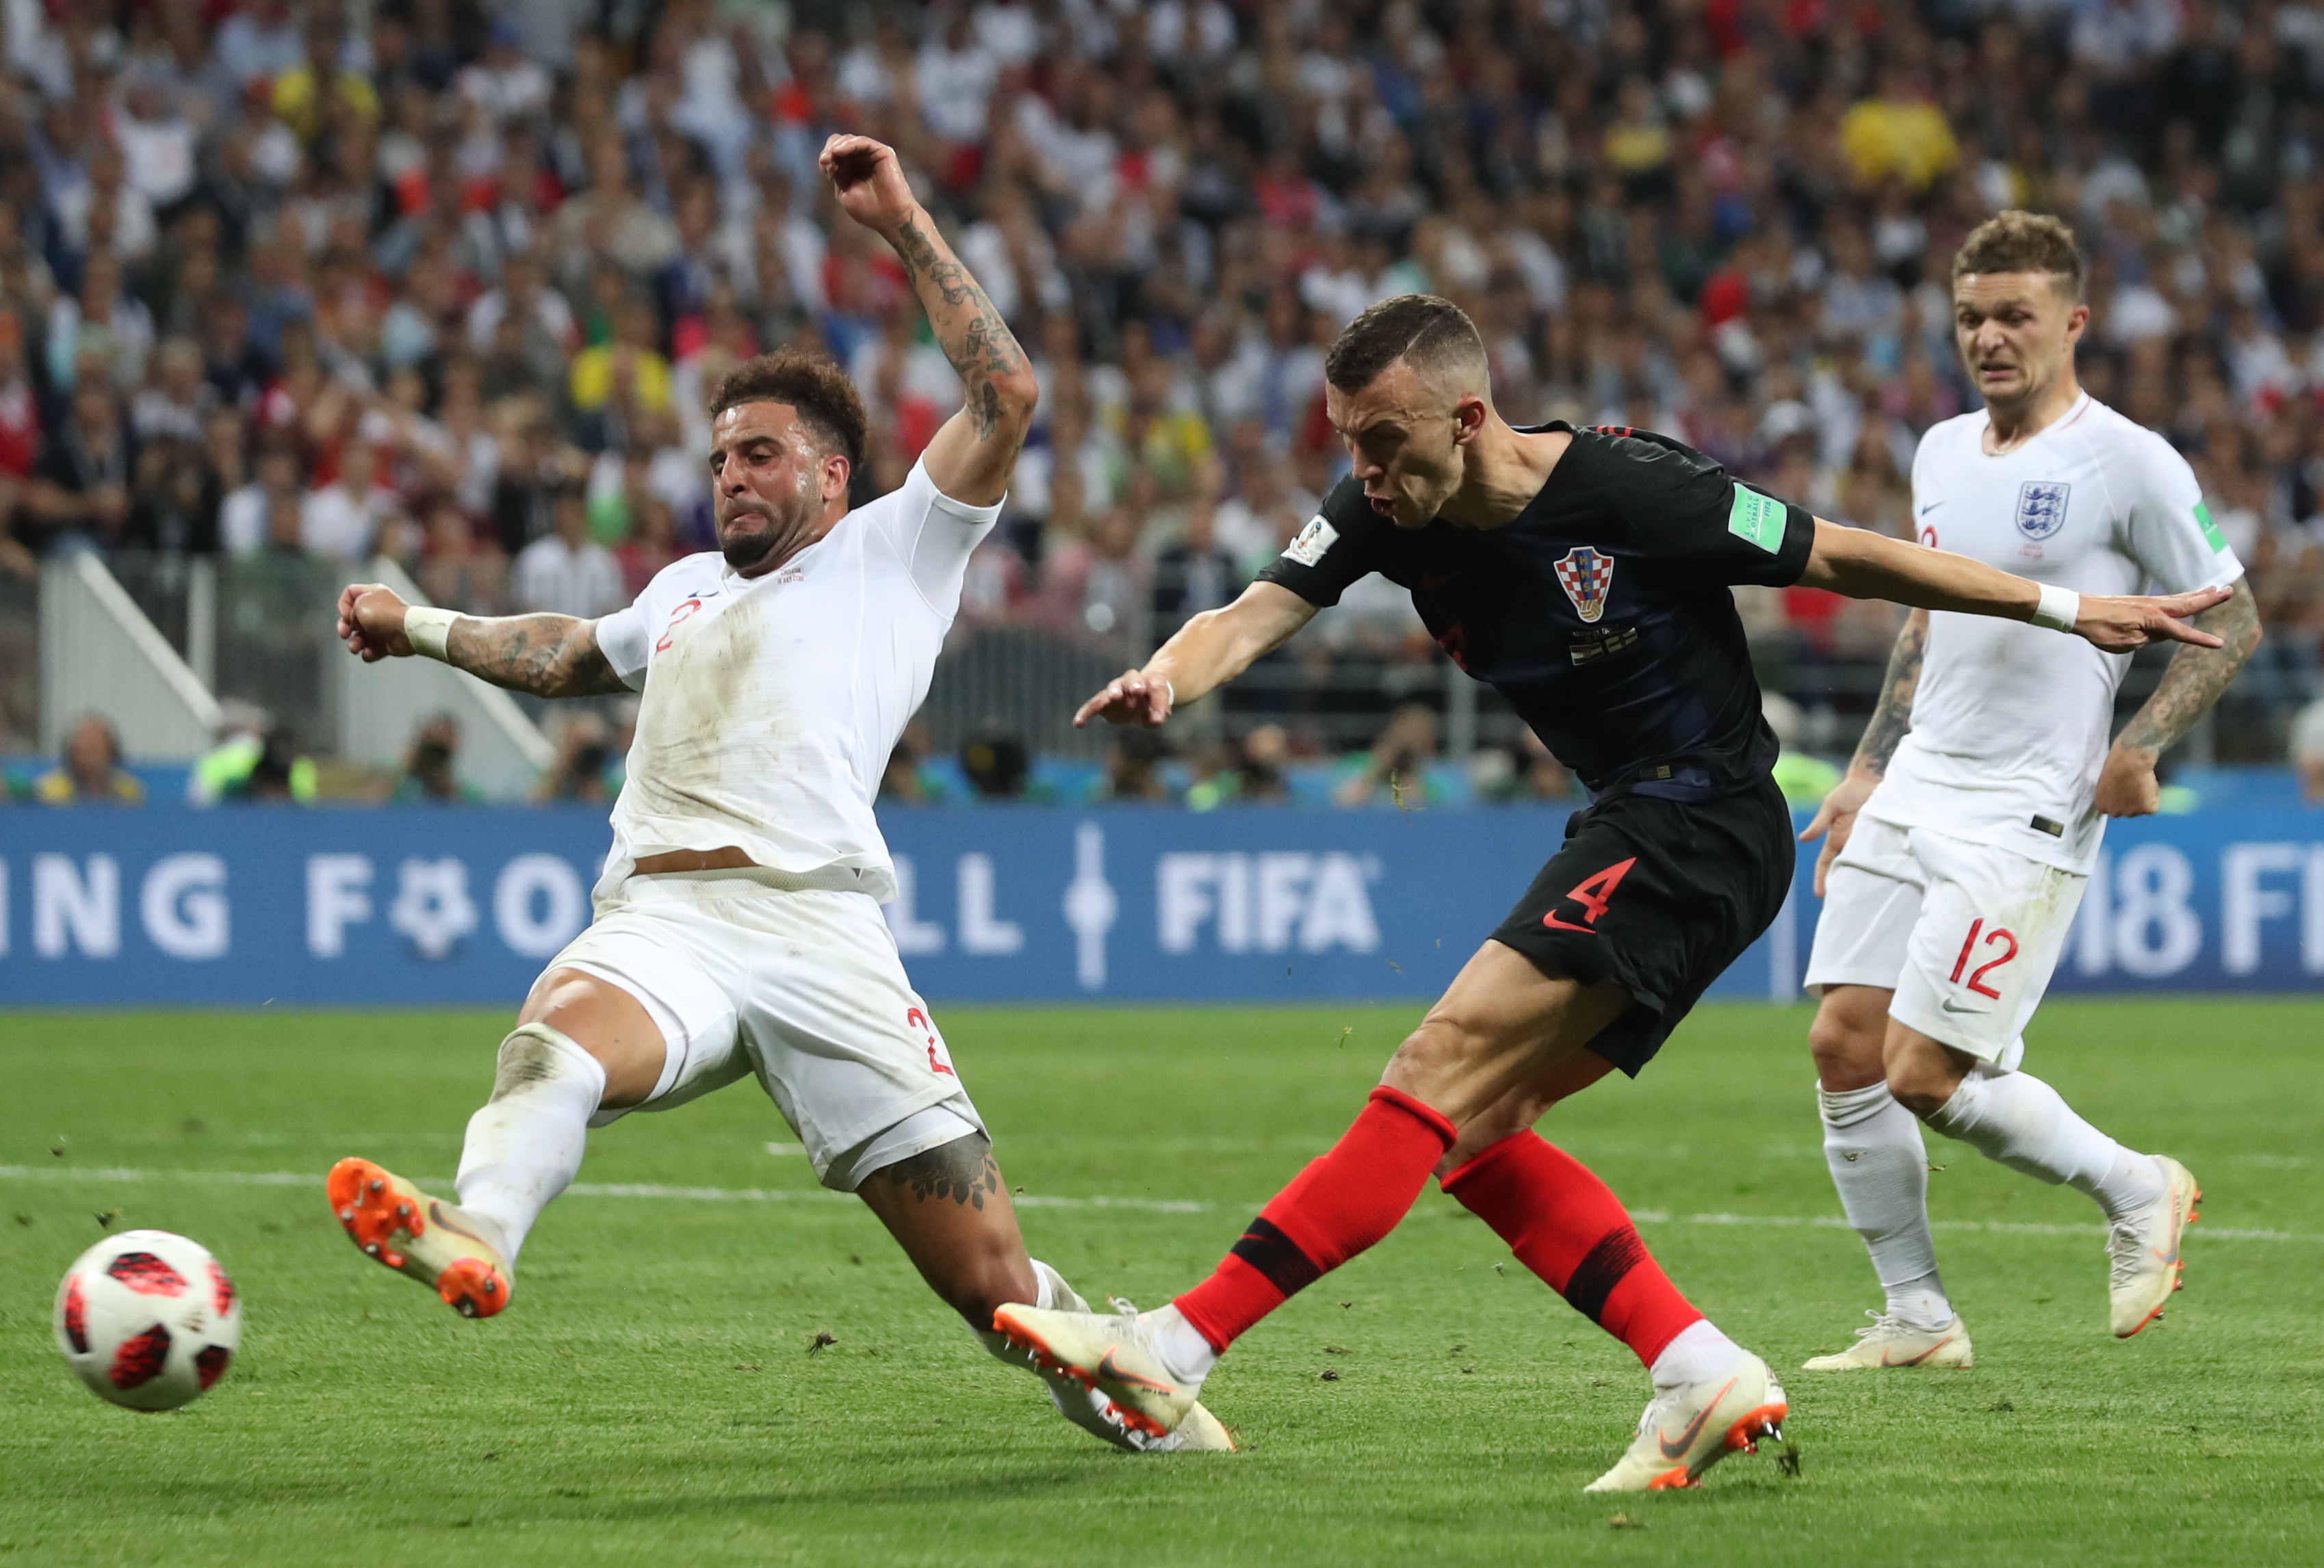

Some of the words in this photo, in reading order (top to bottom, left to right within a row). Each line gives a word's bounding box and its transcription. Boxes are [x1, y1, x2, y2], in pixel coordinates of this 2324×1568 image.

[1745, 495, 1753, 535] LIVING
[1579, 556, 1591, 592] HNS
[655, 599, 701, 655] 2
[0, 851, 231, 961] NG
[1157, 850, 1381, 954] FIFA
[1566, 857, 1638, 924] 4
[2055, 841, 2202, 978] 18
[1949, 917, 2019, 1000] 12
[907, 1007, 955, 1077] 2
